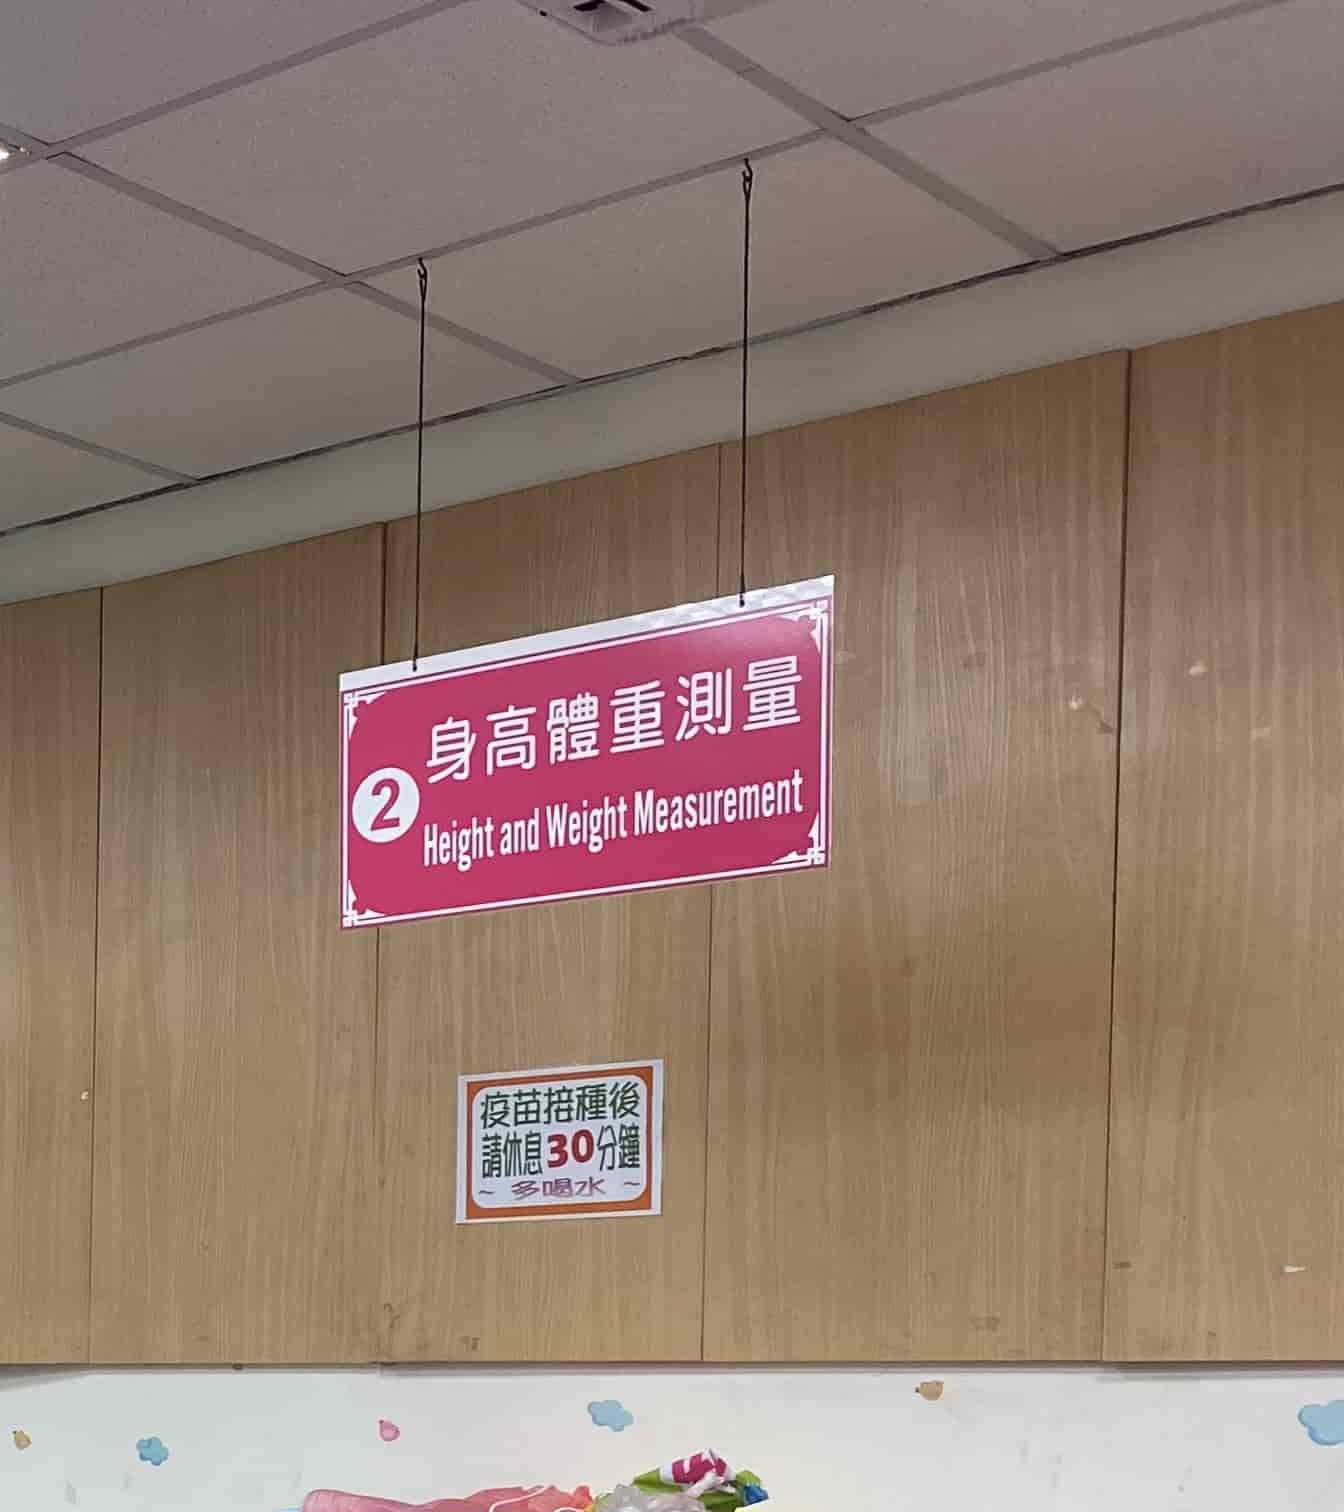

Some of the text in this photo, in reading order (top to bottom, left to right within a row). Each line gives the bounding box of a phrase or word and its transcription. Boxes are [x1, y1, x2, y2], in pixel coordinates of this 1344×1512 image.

[425, 655, 802, 785] 身高體重測量
[423, 768, 804, 872] Height and Weight Measurement
